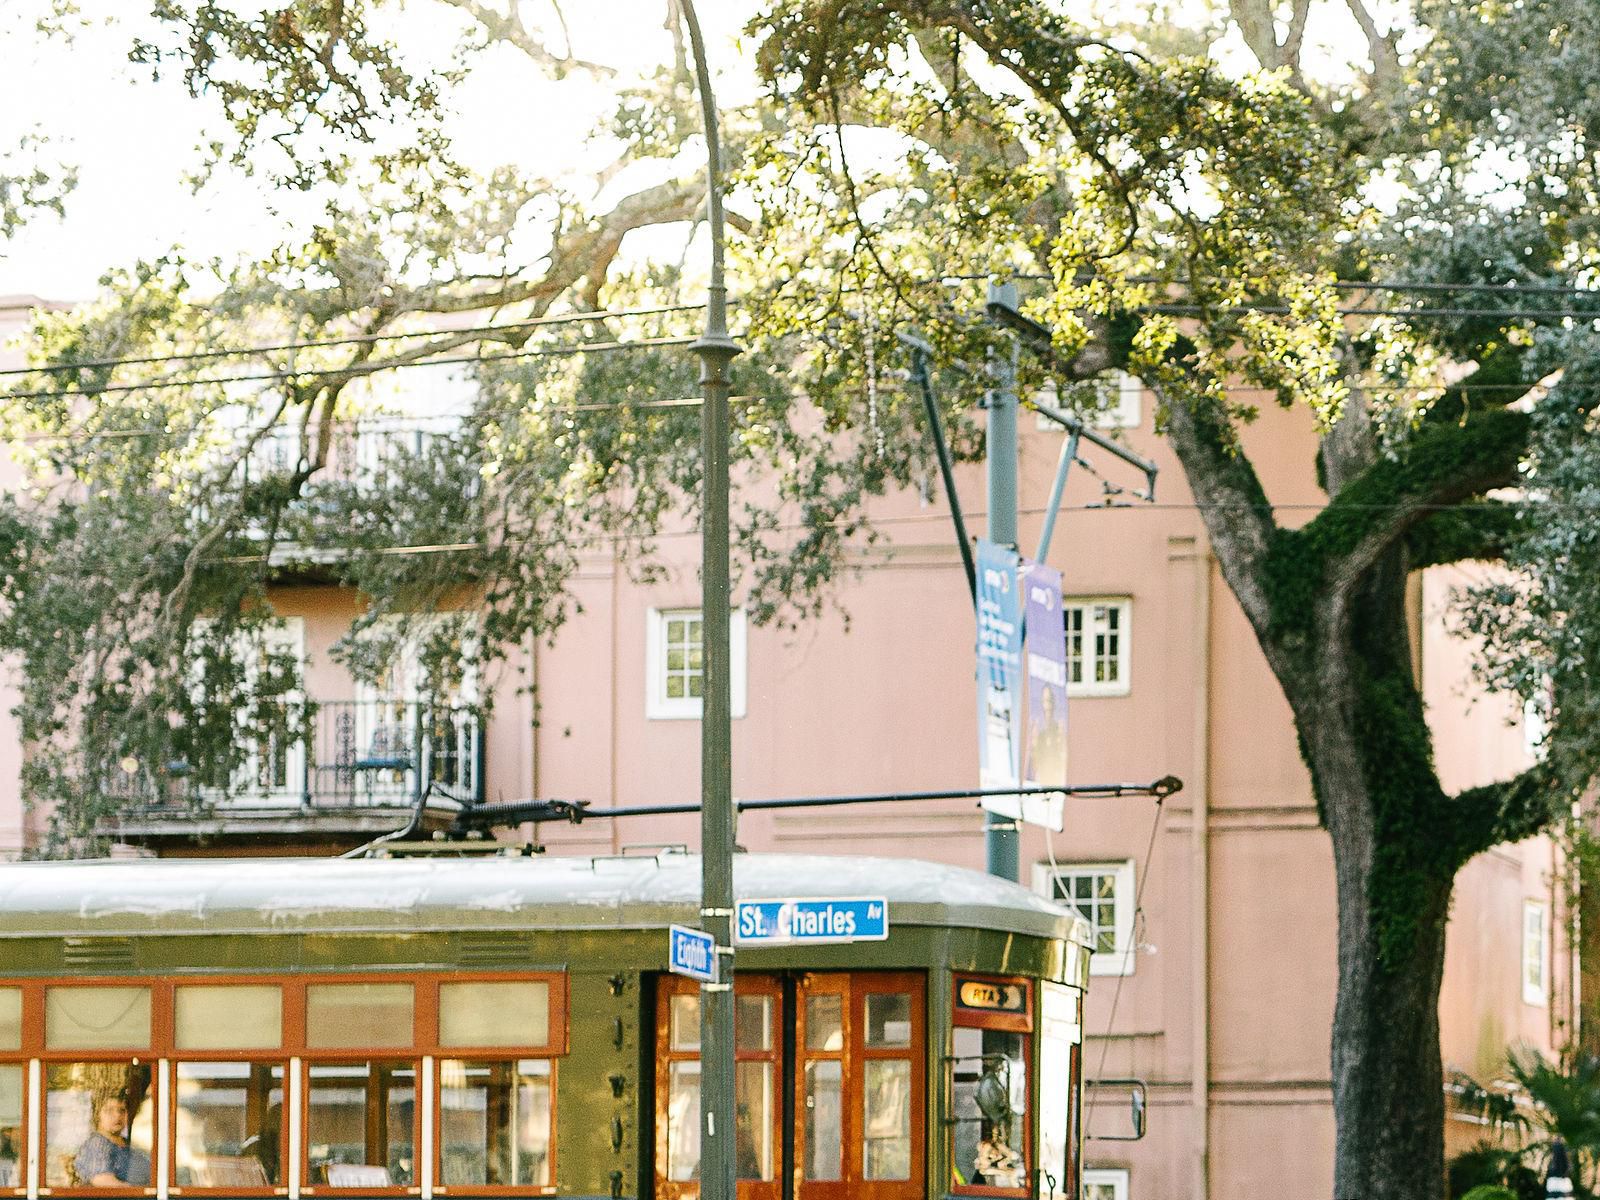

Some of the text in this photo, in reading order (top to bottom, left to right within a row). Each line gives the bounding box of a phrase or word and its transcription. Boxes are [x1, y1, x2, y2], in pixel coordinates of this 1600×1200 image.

[741, 903, 882, 936] St. Charles Av
[973, 988, 994, 1002] RTA
